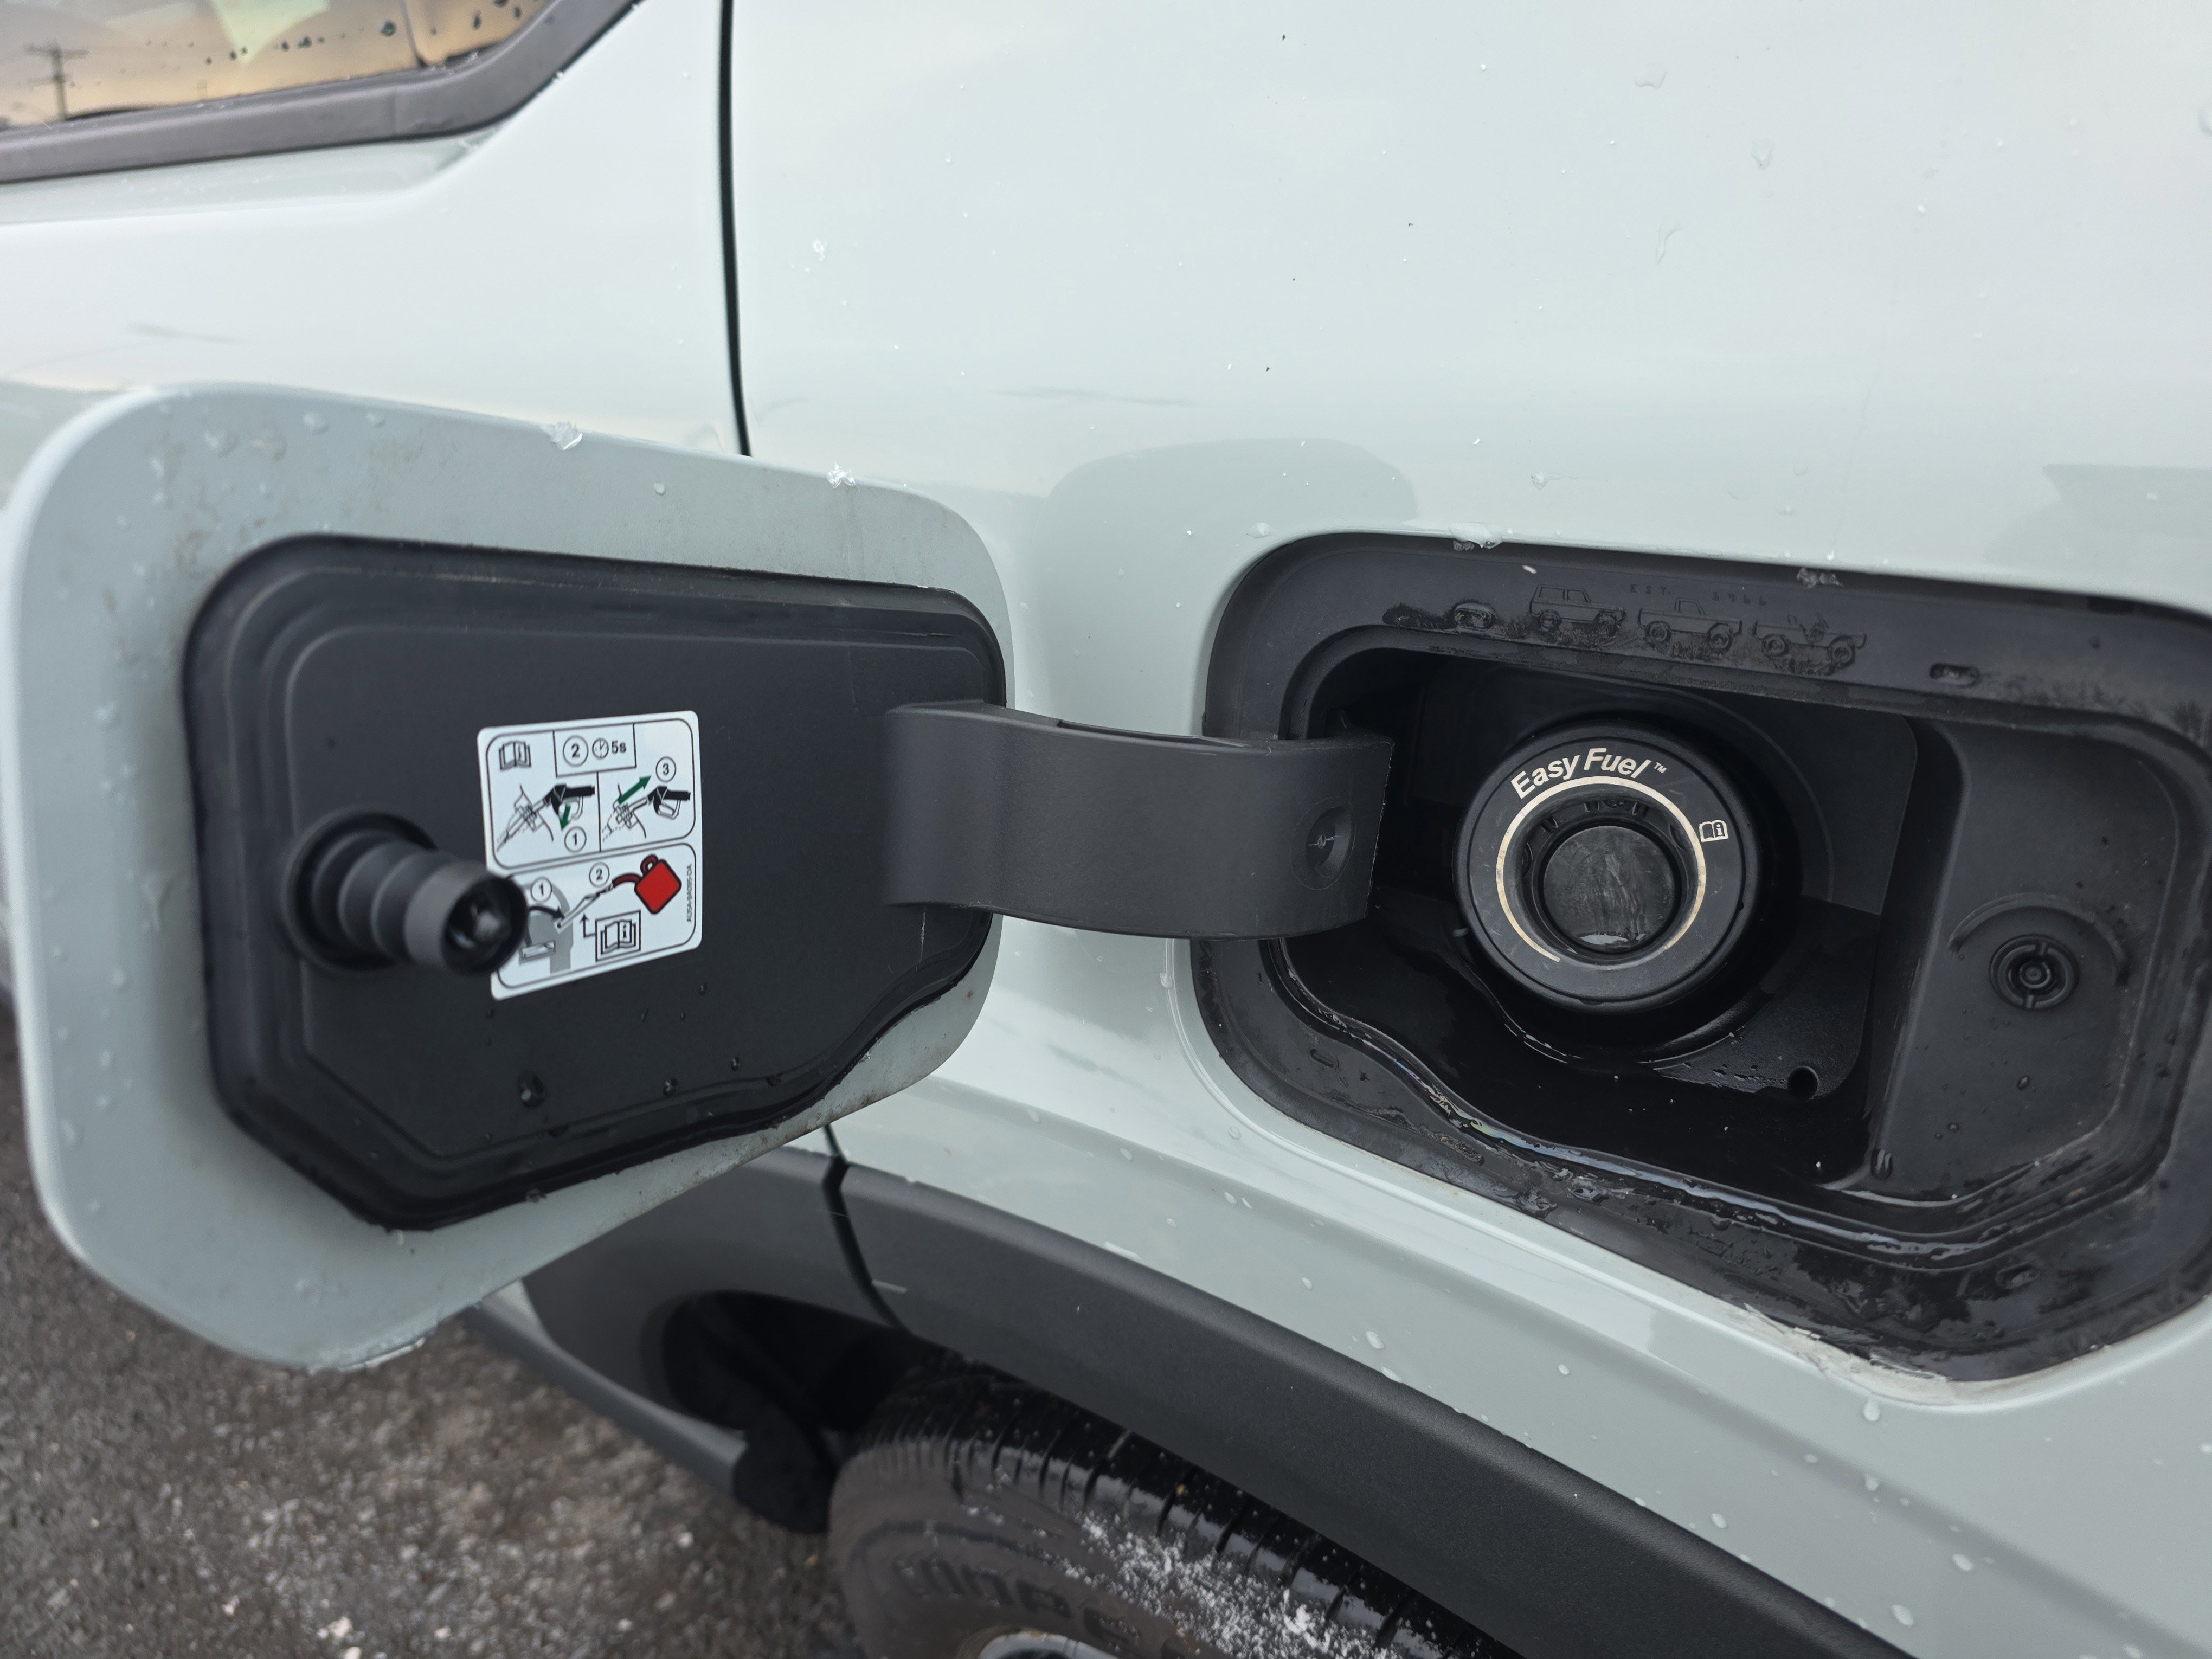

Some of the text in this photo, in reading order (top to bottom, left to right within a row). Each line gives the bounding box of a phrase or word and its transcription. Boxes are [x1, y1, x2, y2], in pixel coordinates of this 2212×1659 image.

[1630, 583, 1670, 596] EST.
[571, 740, 627, 758] 2 5s
[663, 763, 670, 776] 3
[1510, 755, 1580, 799] Easy
[1583, 748, 1651, 779] Fuel
[572, 833, 578, 846] 1
[596, 868, 603, 881] 2
[540, 883, 544, 895] 1
